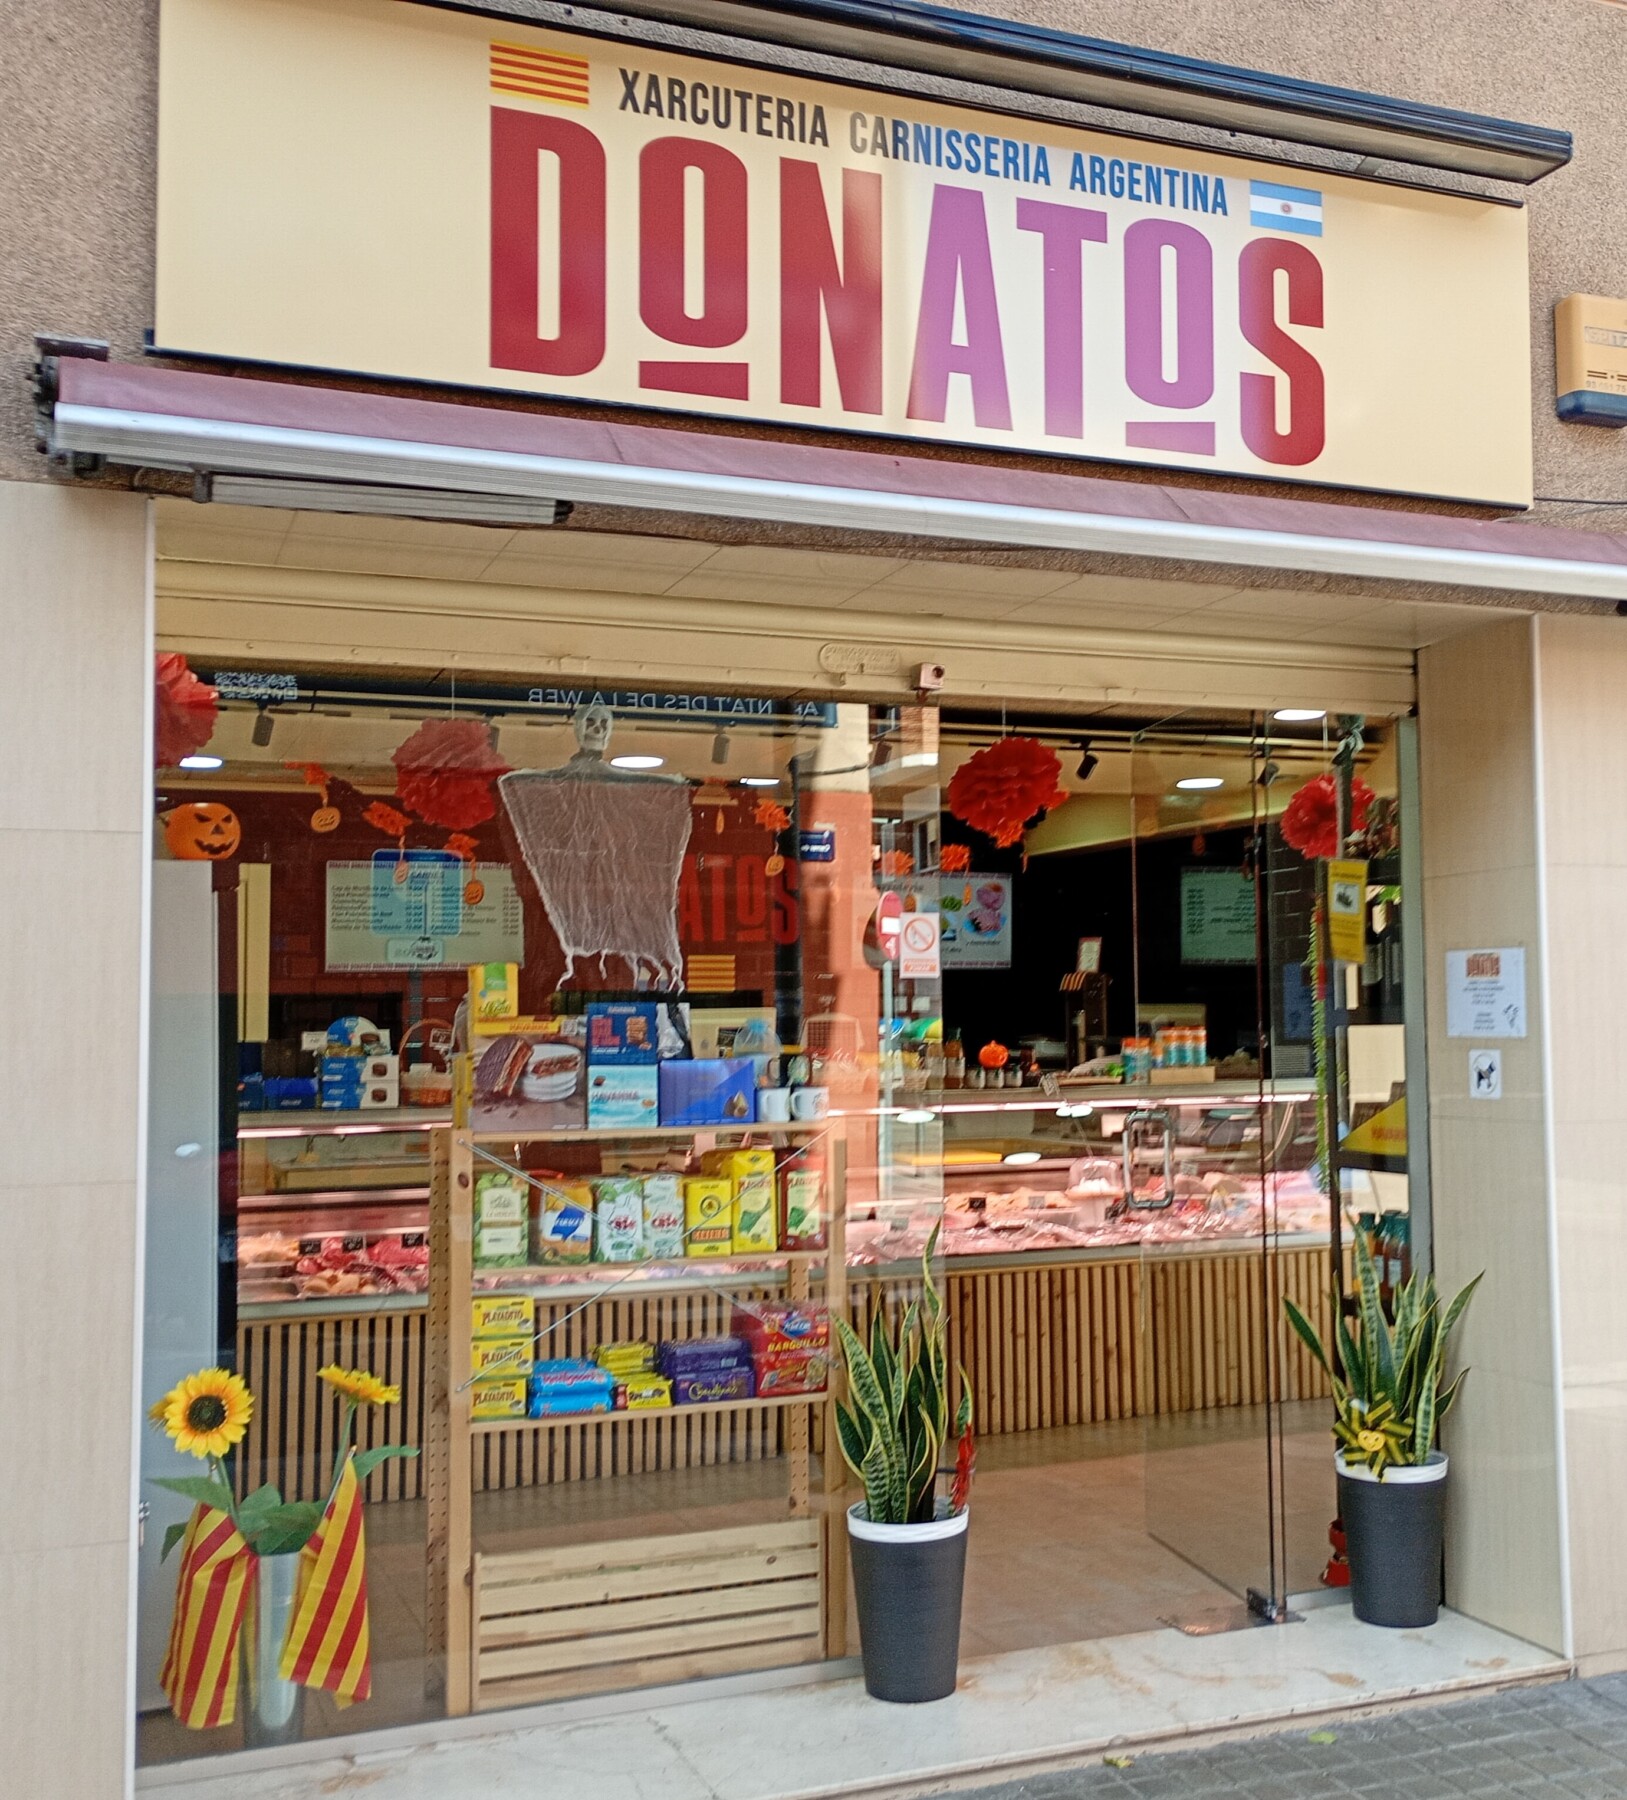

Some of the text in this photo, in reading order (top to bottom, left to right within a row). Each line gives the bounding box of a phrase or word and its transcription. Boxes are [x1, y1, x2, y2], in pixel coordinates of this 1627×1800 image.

[618, 67, 1228, 216] XARCUTERIA CARNISSERIA ARGENTINA
[490, 105, 1326, 466] DONATOS
[678, 854, 800, 944] ATOS
[482, 1310, 523, 1327] PLAYADITO
[473, 1391, 516, 1407] PLAYADITO
